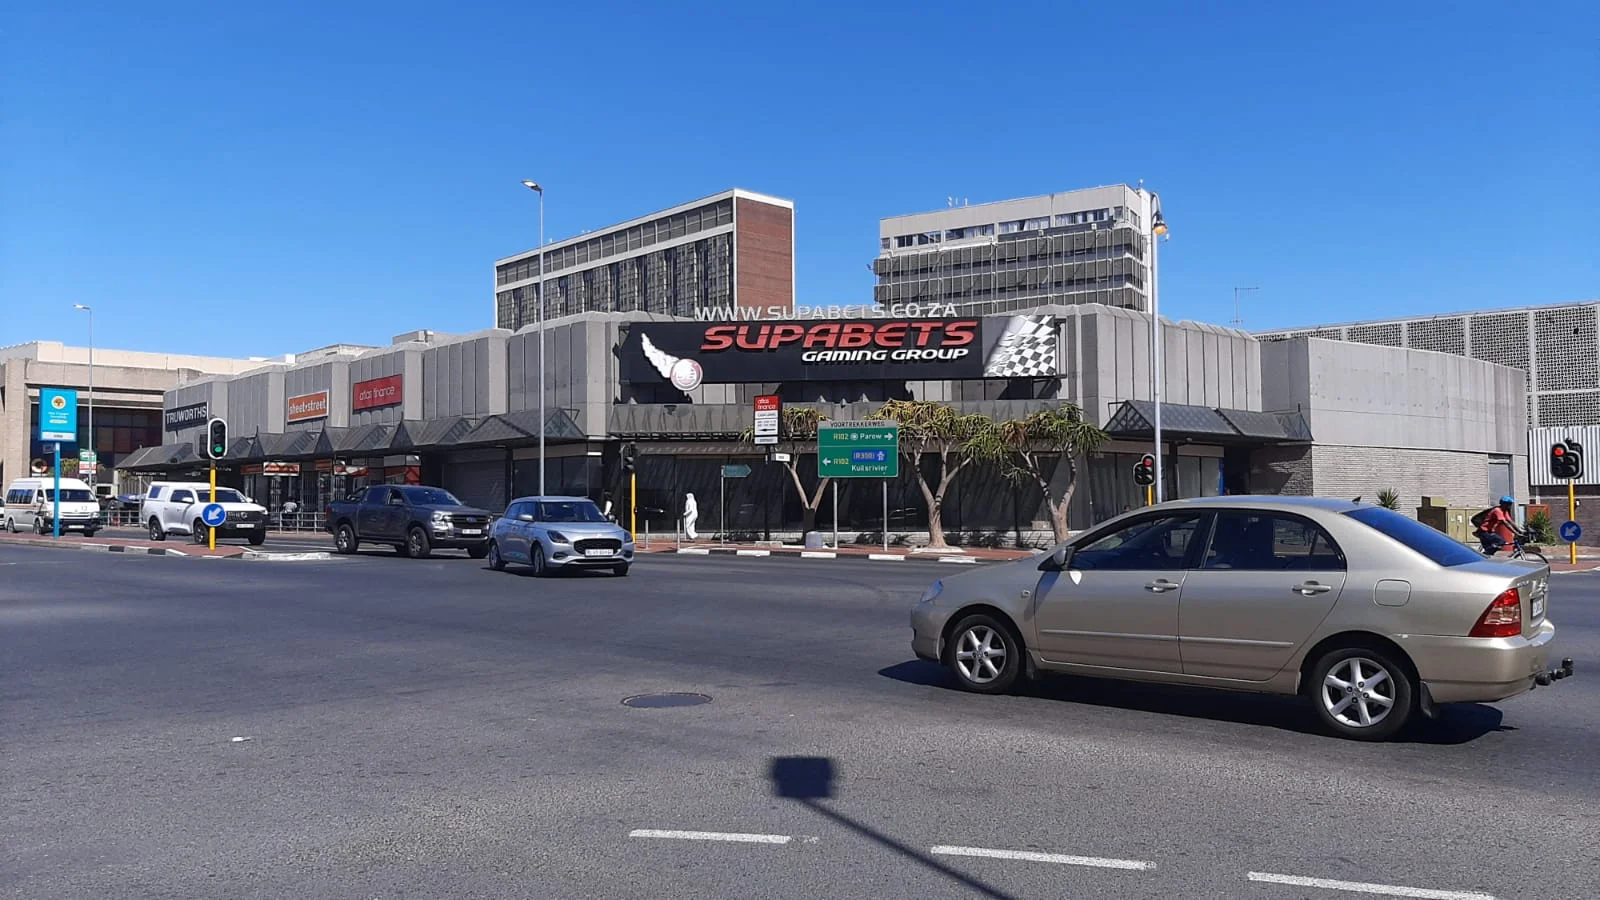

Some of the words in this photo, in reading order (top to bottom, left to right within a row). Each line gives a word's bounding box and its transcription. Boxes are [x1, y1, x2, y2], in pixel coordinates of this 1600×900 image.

[694, 302, 958, 321] WWW.SUPABETS.CO.ZA
[700, 321, 978, 350] SUPABETS
[801, 350, 889, 362] GAMING
[891, 348, 969, 361] GROUP
[374, 386, 395, 398] finance
[166, 405, 207, 425] TRUWORTHS
[851, 464, 888, 472] Kuilsrivier
